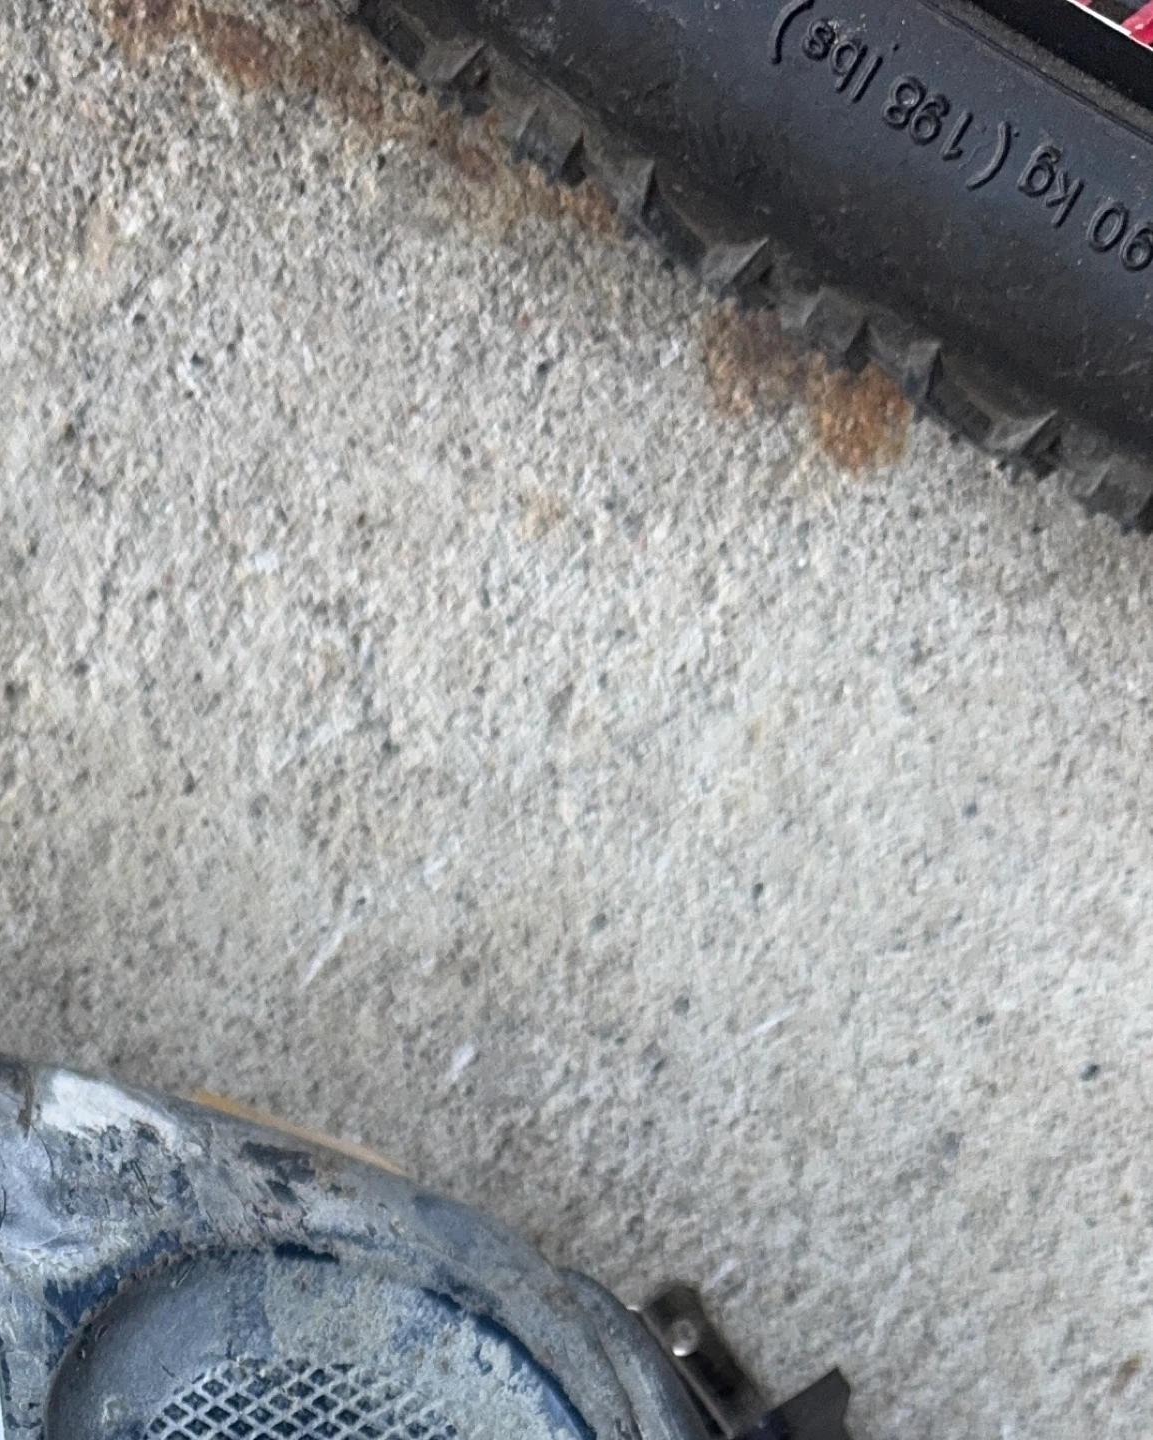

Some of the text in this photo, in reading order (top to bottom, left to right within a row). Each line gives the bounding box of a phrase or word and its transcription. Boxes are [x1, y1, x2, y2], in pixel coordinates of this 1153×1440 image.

[769, 0, 884, 103] lbs)
[1017, 144, 1085, 229] kg
[1087, 200, 1153, 273] 90
